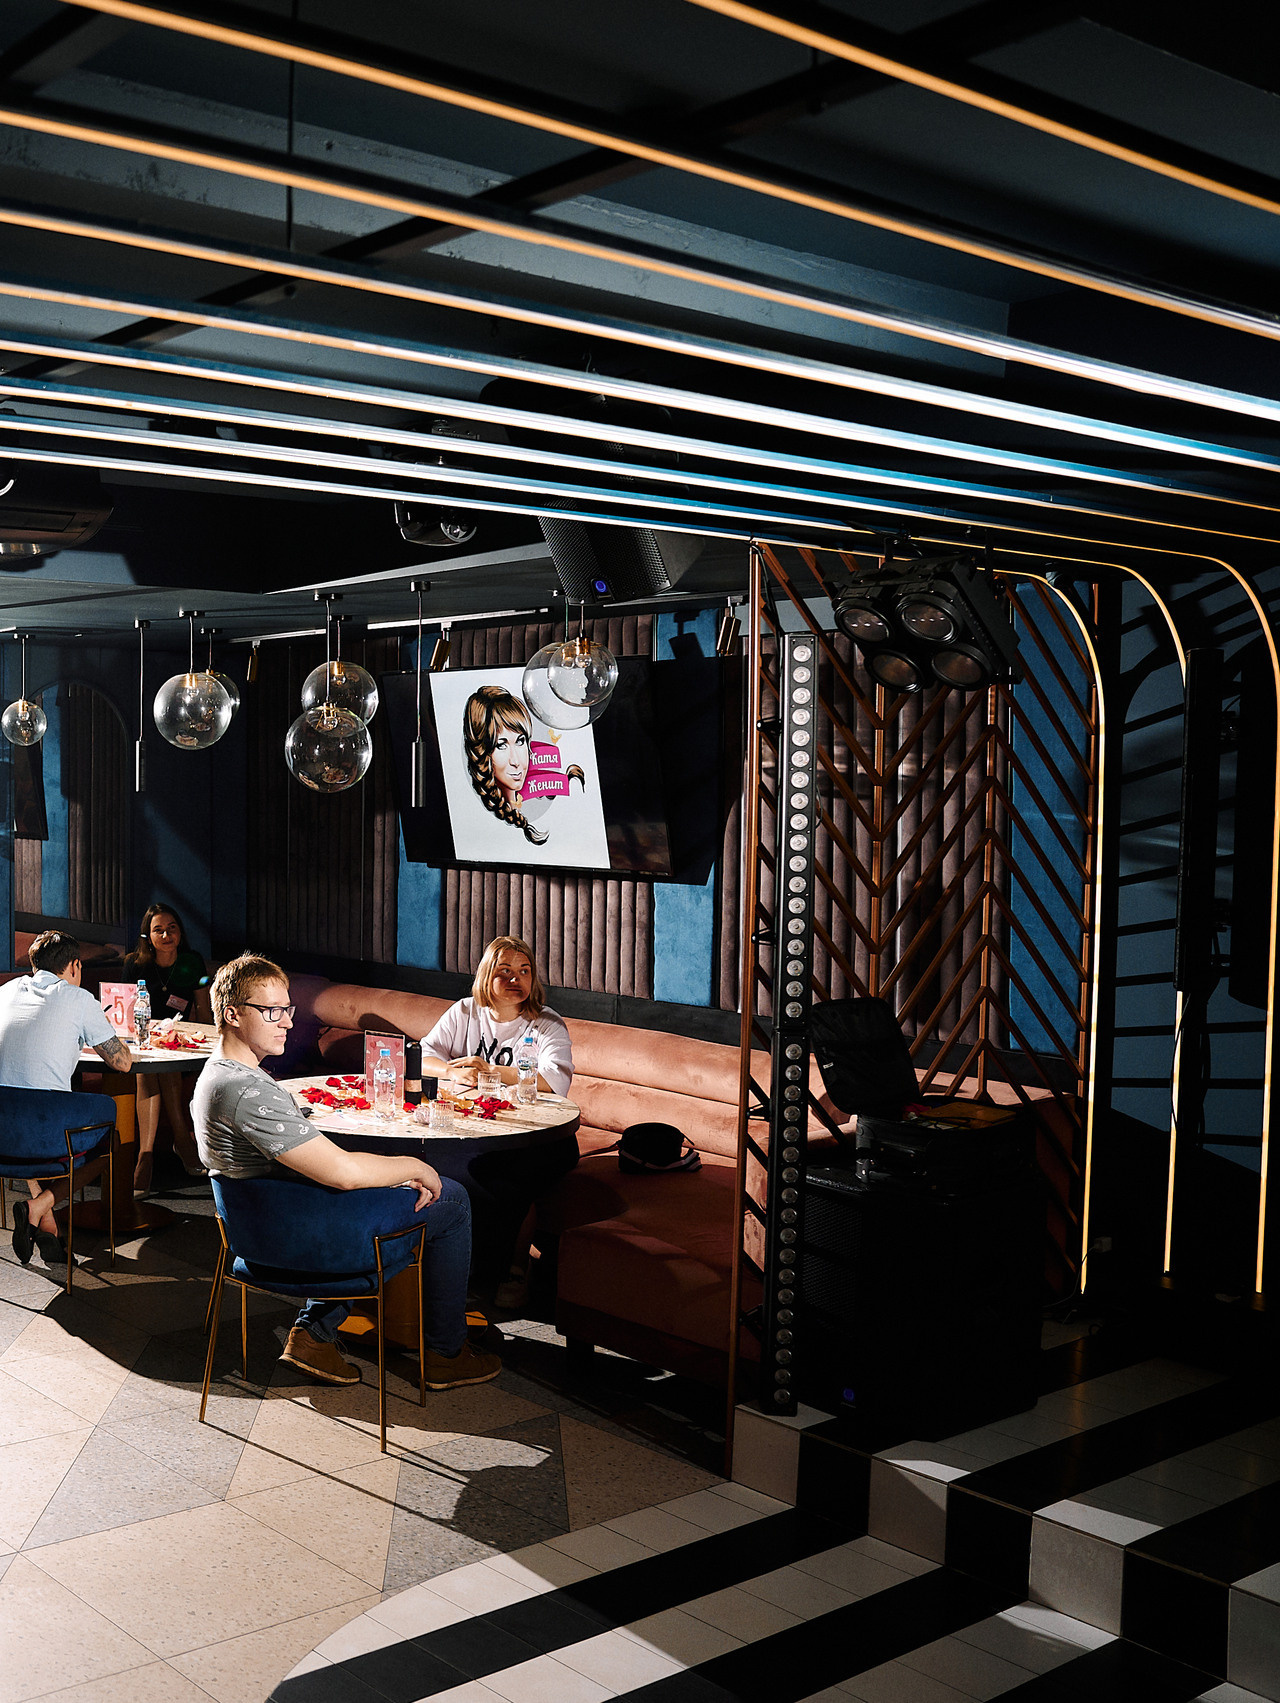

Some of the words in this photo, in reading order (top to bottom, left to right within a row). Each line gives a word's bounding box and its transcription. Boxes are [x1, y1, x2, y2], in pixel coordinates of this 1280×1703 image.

[530, 752, 559, 766] Катя
[528, 779, 564, 794] Женит
[114, 995, 125, 1026] 5
